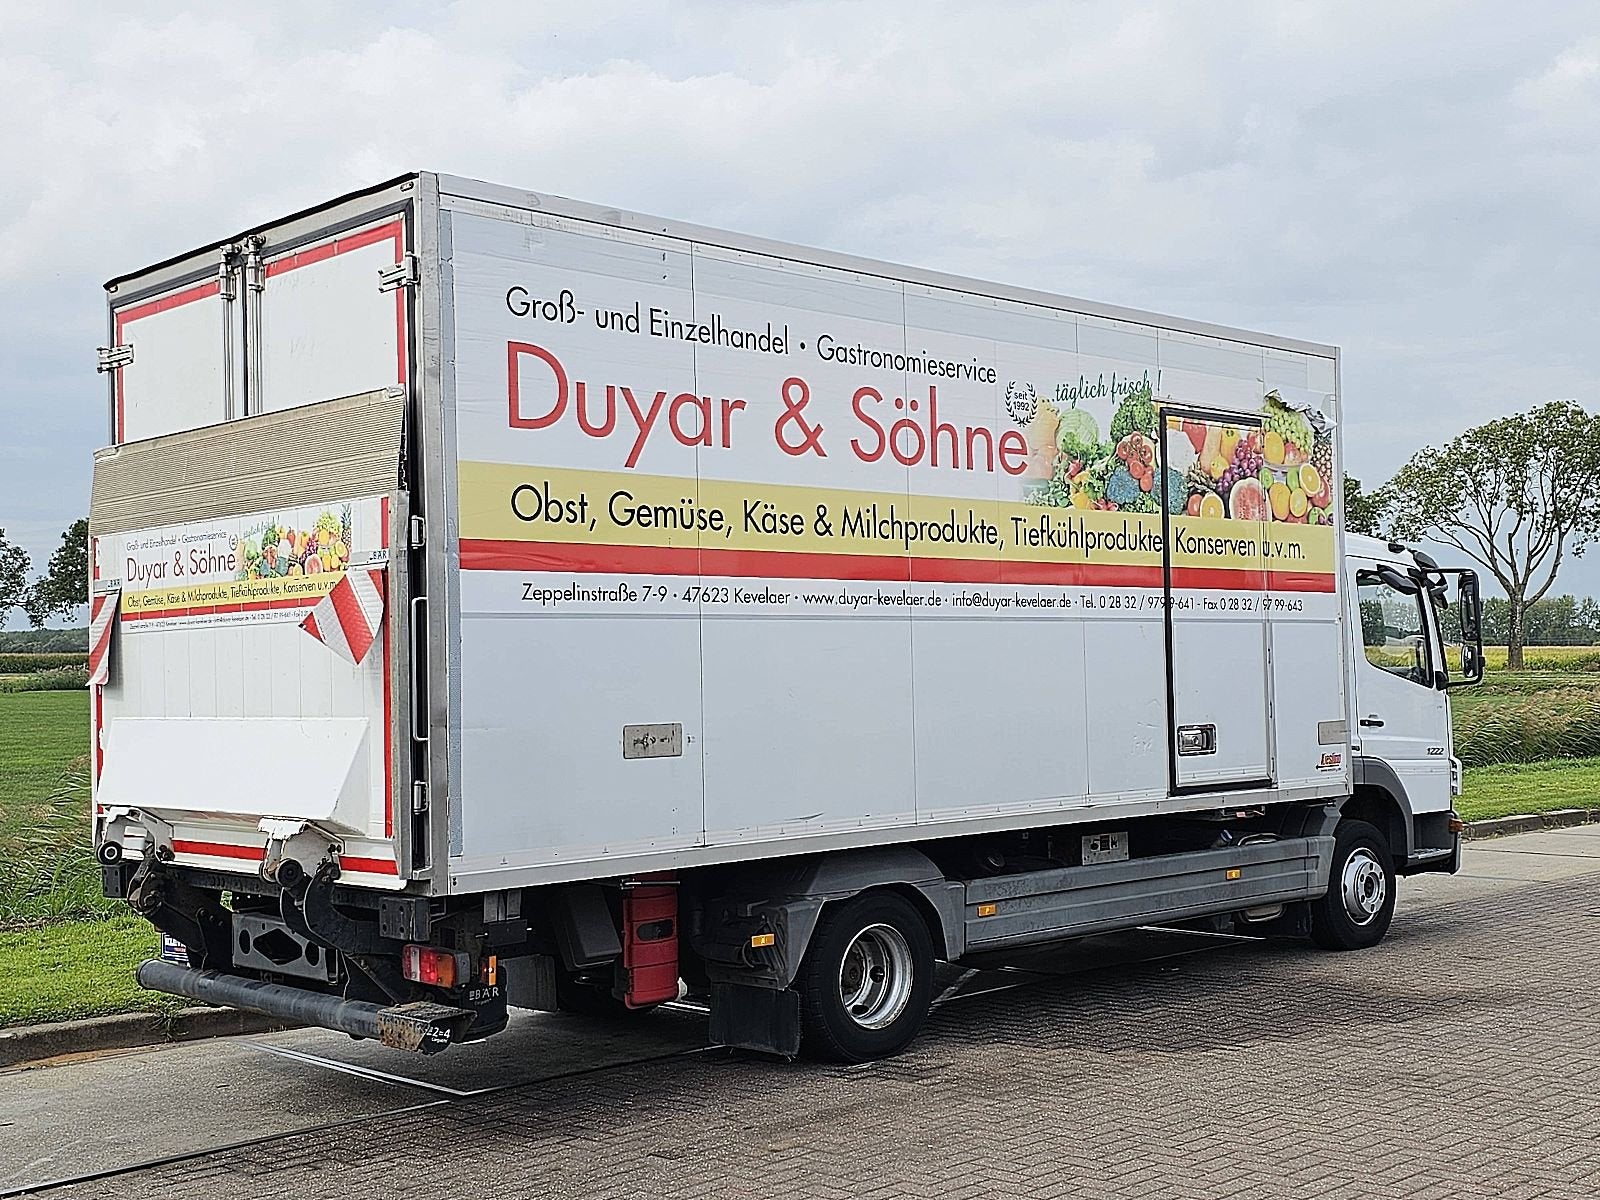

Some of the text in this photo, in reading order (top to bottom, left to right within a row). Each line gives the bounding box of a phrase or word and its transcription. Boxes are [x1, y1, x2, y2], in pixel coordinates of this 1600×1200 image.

[506, 286, 997, 384] Groß- und Einzelhandel Gastronomieservice
[507, 340, 1028, 475] Duyar & Söhne
[1012, 402, 1030, 412] 1992
[1013, 389, 1028, 400] seit
[510, 481, 597, 532] Obst,
[608, 490, 733, 538] Gemüse,
[743, 499, 805, 536] Käse
[813, 504, 833, 537] &
[841, 503, 1005, 551] Milchprodukte,
[1175, 526, 1256, 557] Konserven
[127, 543, 236, 589] Duyar & Söhne
[521, 581, 638, 606] Zeppelinstraße
[642, 585, 668, 602] 7-9
[682, 586, 729, 603] 47623
[734, 586, 791, 604] Kevelaer
[802, 587, 942, 609] www.duyar-kevelaer.de
[952, 592, 1072, 611] info@duyar-kevelaer.de
[1080, 593, 1096, 609] Tel.
[1099, 596, 1106, 609] 0
[1108, 596, 1121, 609] 28
[1124, 596, 1137, 609] 32
[1203, 597, 1219, 611] Fax
[1220, 597, 1227, 611] 0
[1228, 598, 1240, 611] 28
[1241, 598, 1253, 611] 32
[1274, 599, 1303, 612] 99-643
[1426, 747, 1445, 756] 1222
